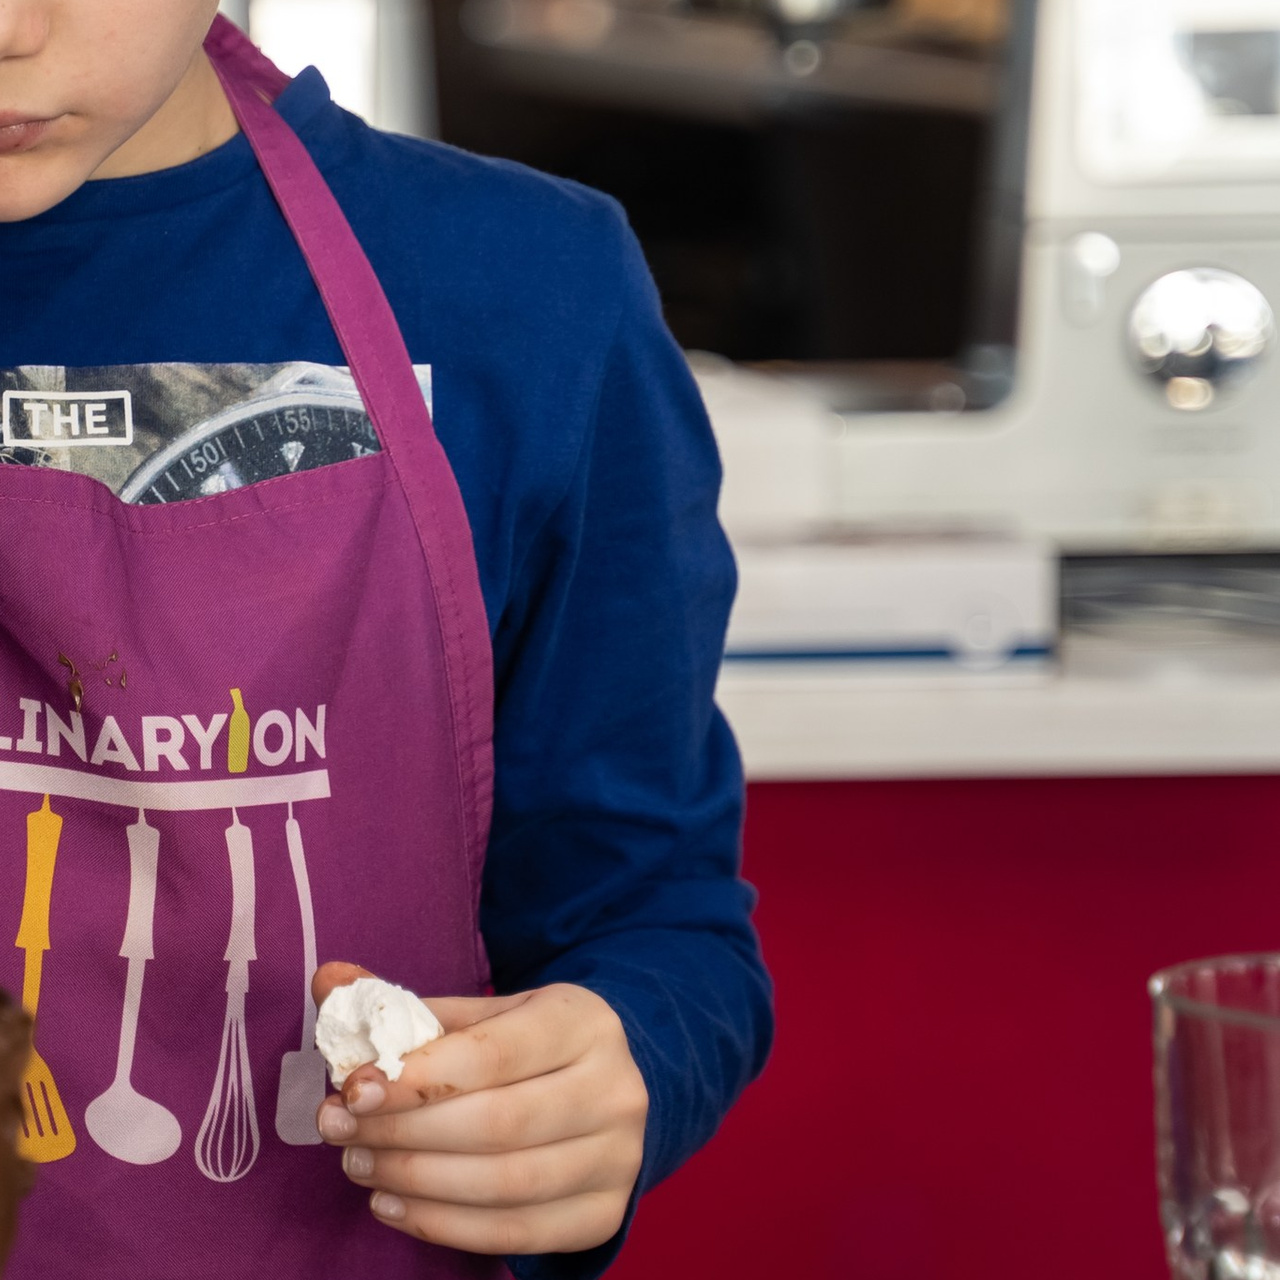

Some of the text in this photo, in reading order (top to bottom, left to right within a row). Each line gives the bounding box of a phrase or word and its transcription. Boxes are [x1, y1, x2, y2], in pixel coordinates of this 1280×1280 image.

[23, 402, 110, 437] THE
[284, 407, 311, 434] 55
[190, 441, 220, 473] 50
